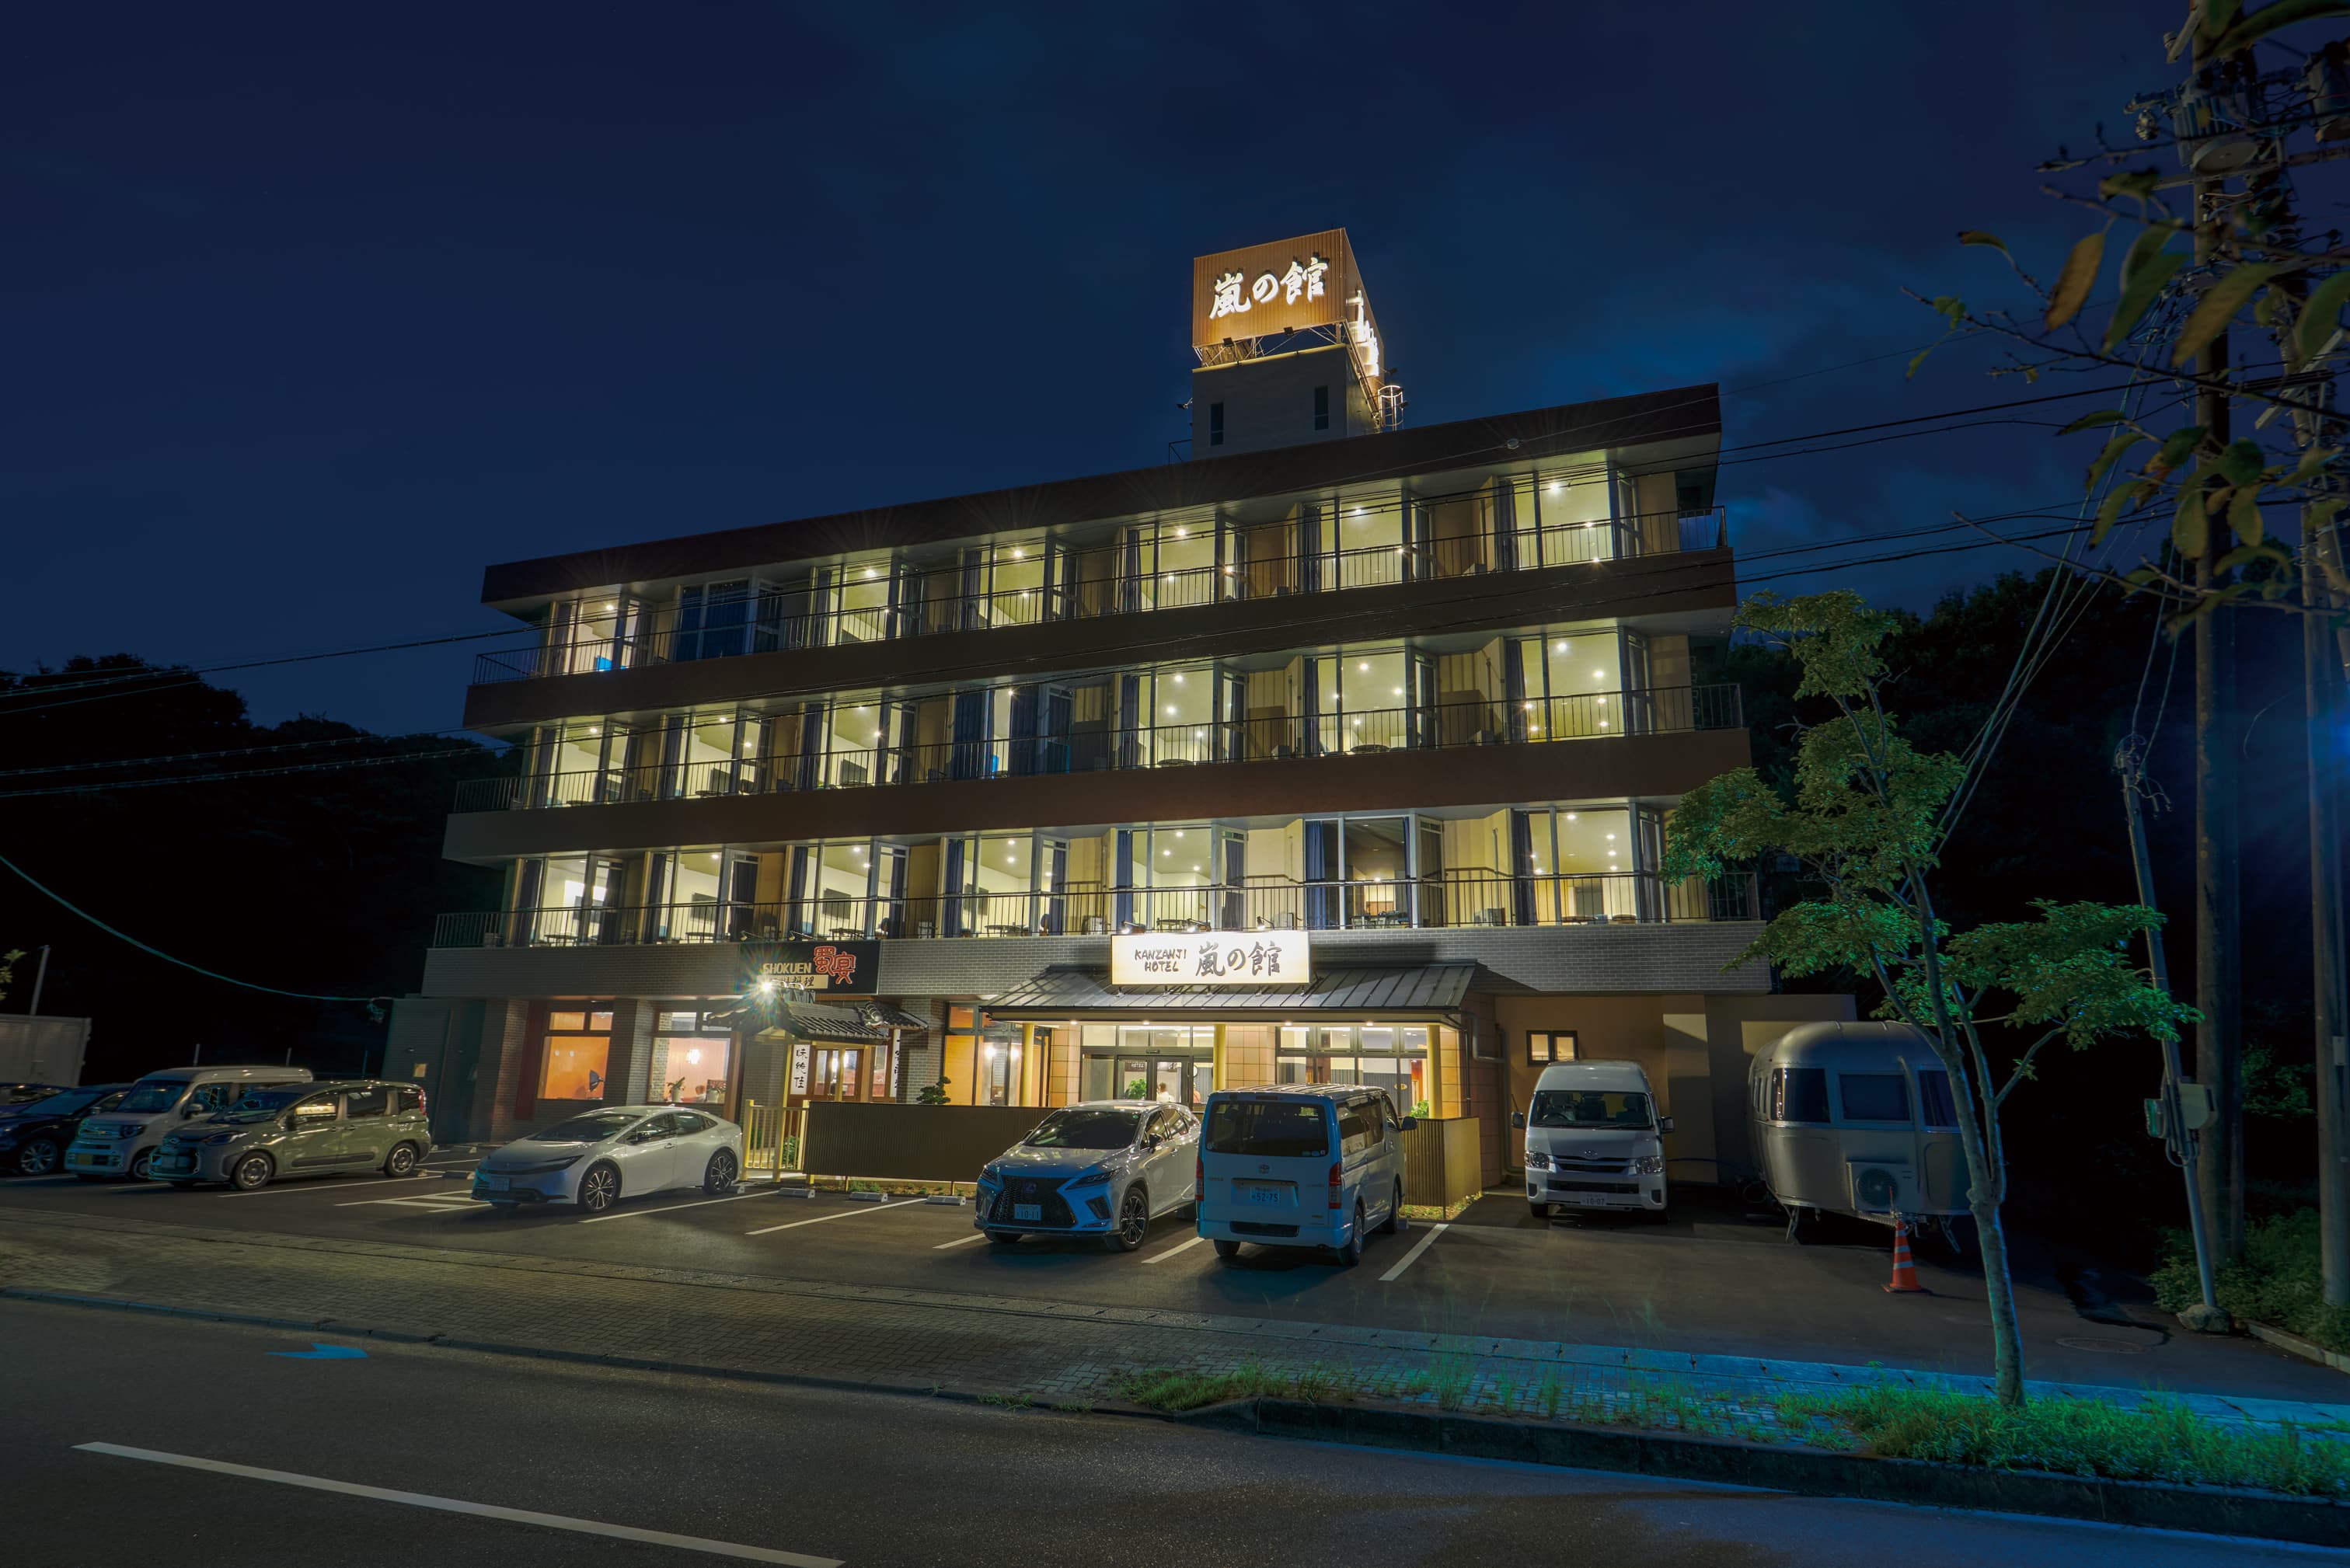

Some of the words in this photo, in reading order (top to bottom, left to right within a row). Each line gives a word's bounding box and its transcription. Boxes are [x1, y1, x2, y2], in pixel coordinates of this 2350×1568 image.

[1209, 257, 1328, 319] 嵐の館
[814, 946, 856, 984] 蜀宴
[1135, 949, 1187, 960] KANZANJI
[1144, 961, 1179, 972] HOTEL
[1195, 941, 1282, 977] 嵐の館
[762, 962, 811, 974] SHOKUEN
